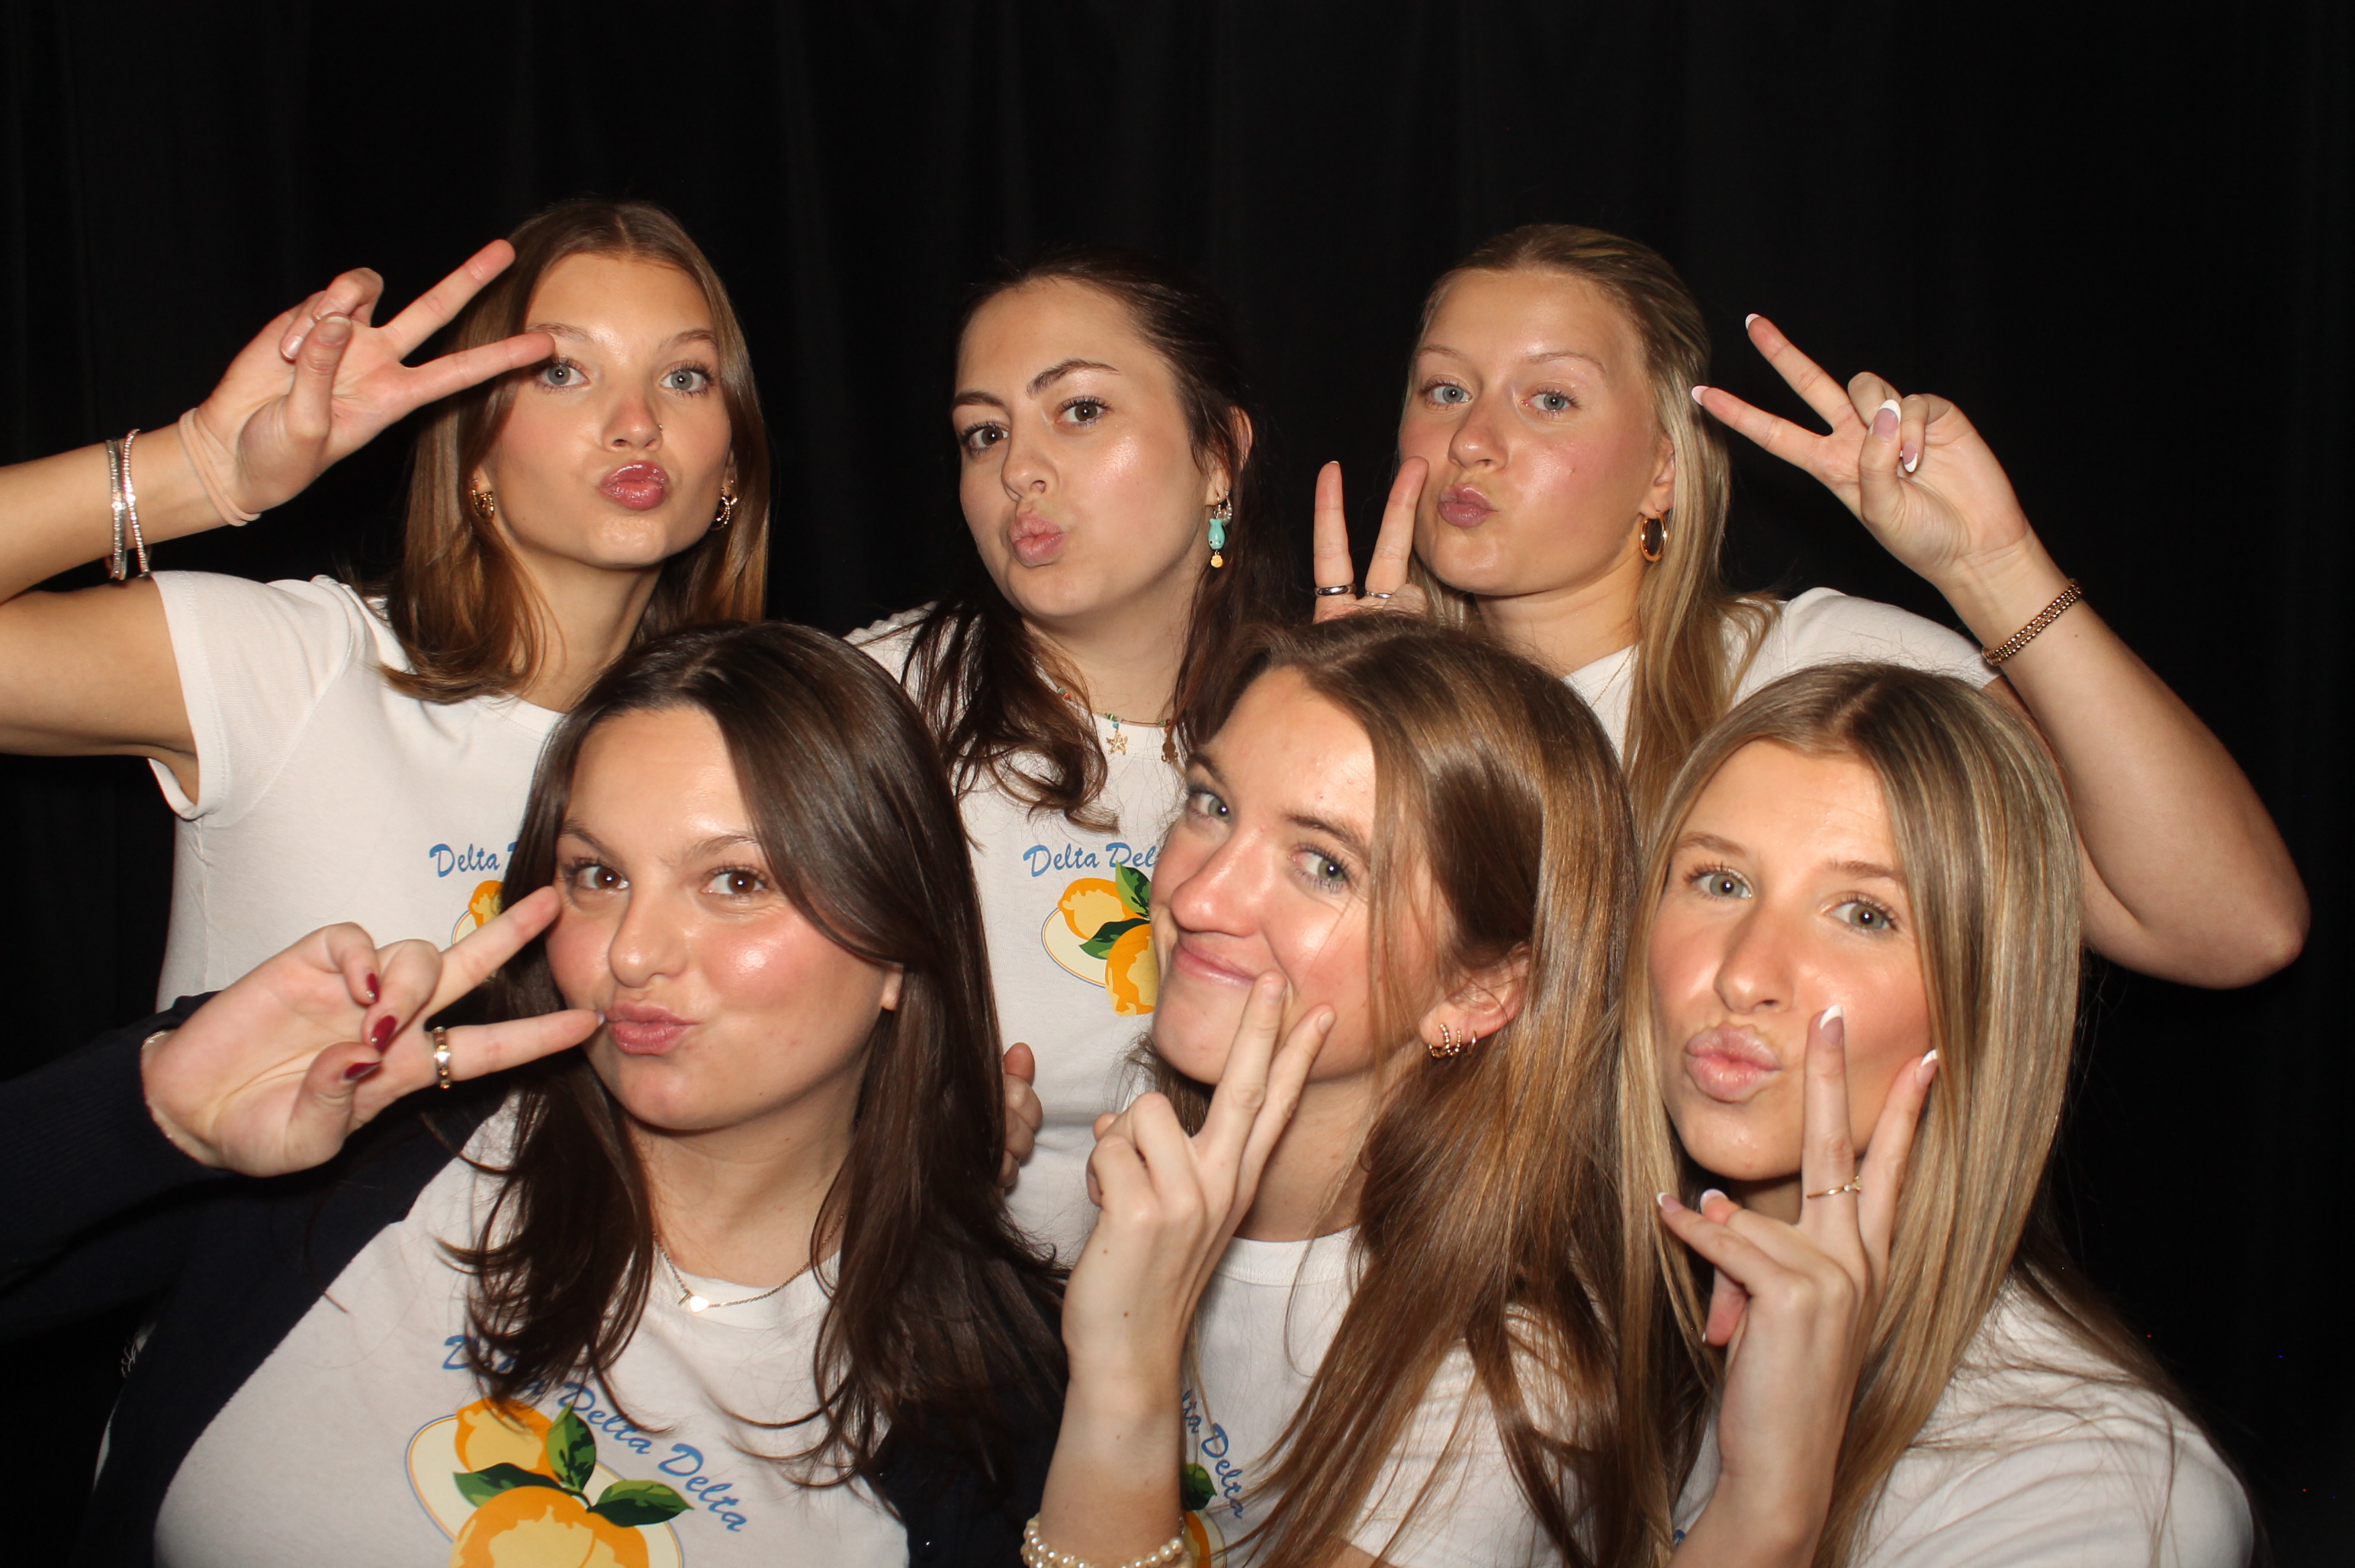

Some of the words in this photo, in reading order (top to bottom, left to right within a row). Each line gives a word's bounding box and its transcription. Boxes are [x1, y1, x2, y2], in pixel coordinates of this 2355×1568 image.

[429, 843, 500, 878] Delta
[1023, 843, 1100, 877] Delta
[1105, 842, 1157, 868] Del
[557, 1381, 654, 1455] Delta
[657, 1443, 747, 1532] Delta
[1200, 1422, 1245, 1519] Delta
